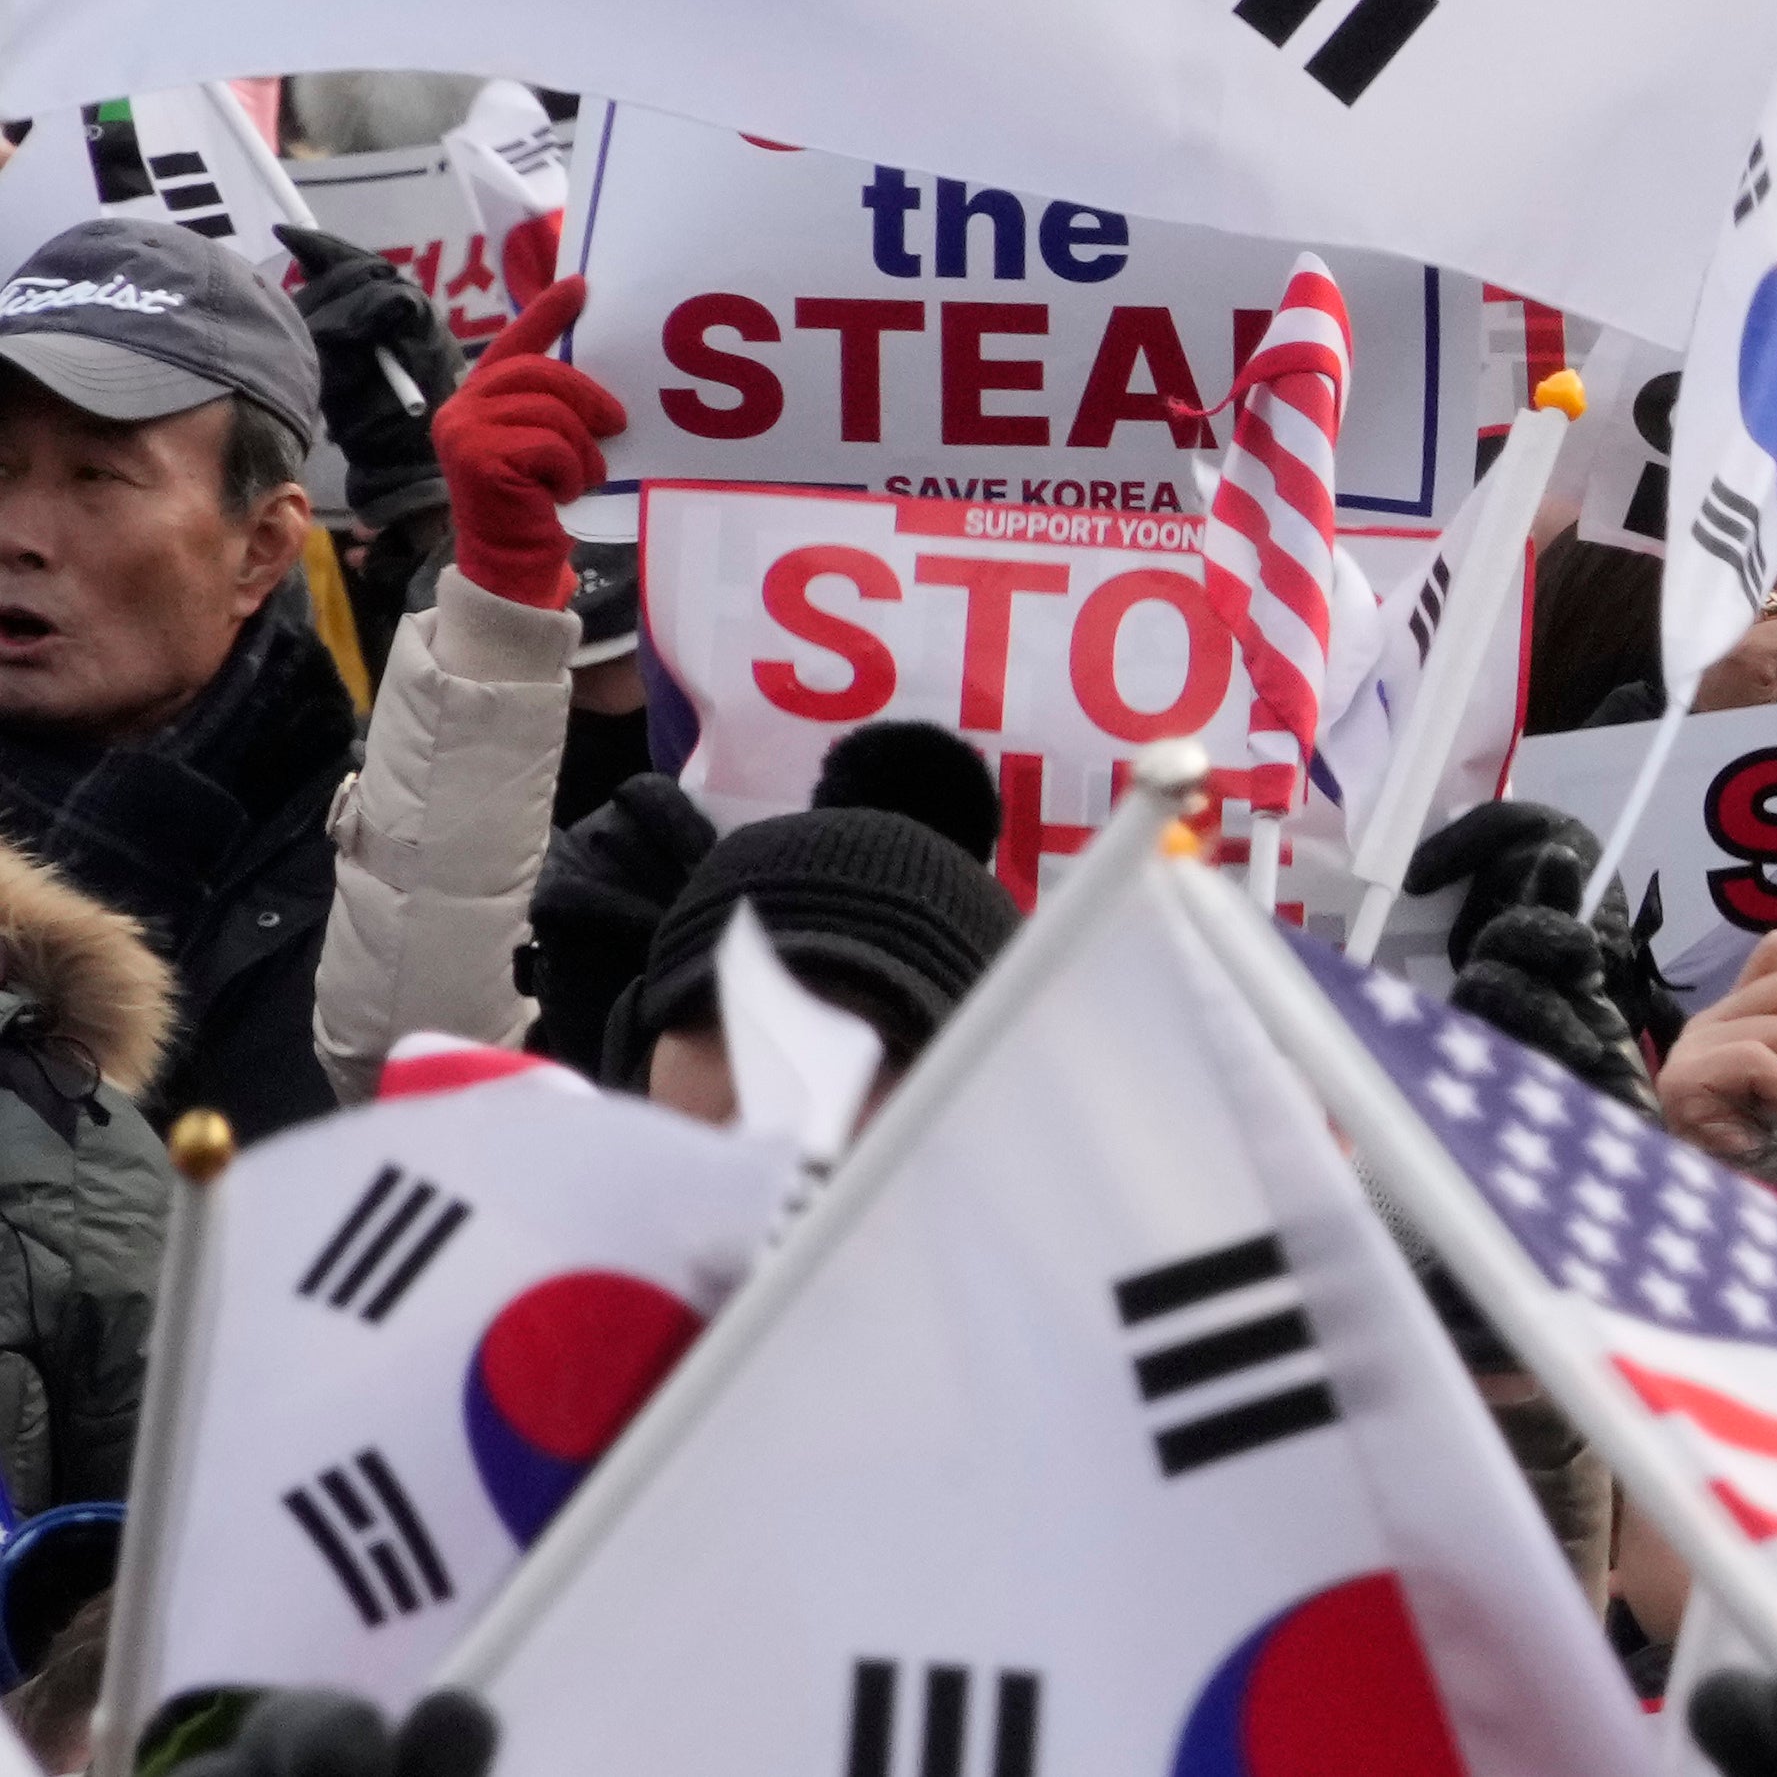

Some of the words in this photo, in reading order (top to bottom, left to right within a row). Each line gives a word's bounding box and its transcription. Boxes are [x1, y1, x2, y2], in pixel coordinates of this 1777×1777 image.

[862, 164, 1130, 284] the
[657, 292, 1274, 451] STEA
[883, 474, 1010, 502] SAVE
[1022, 478, 1182, 513] KOREA
[963, 507, 1109, 545] SUPPORT
[1116, 513, 1204, 553] YOON
[750, 543, 1235, 743] STO
